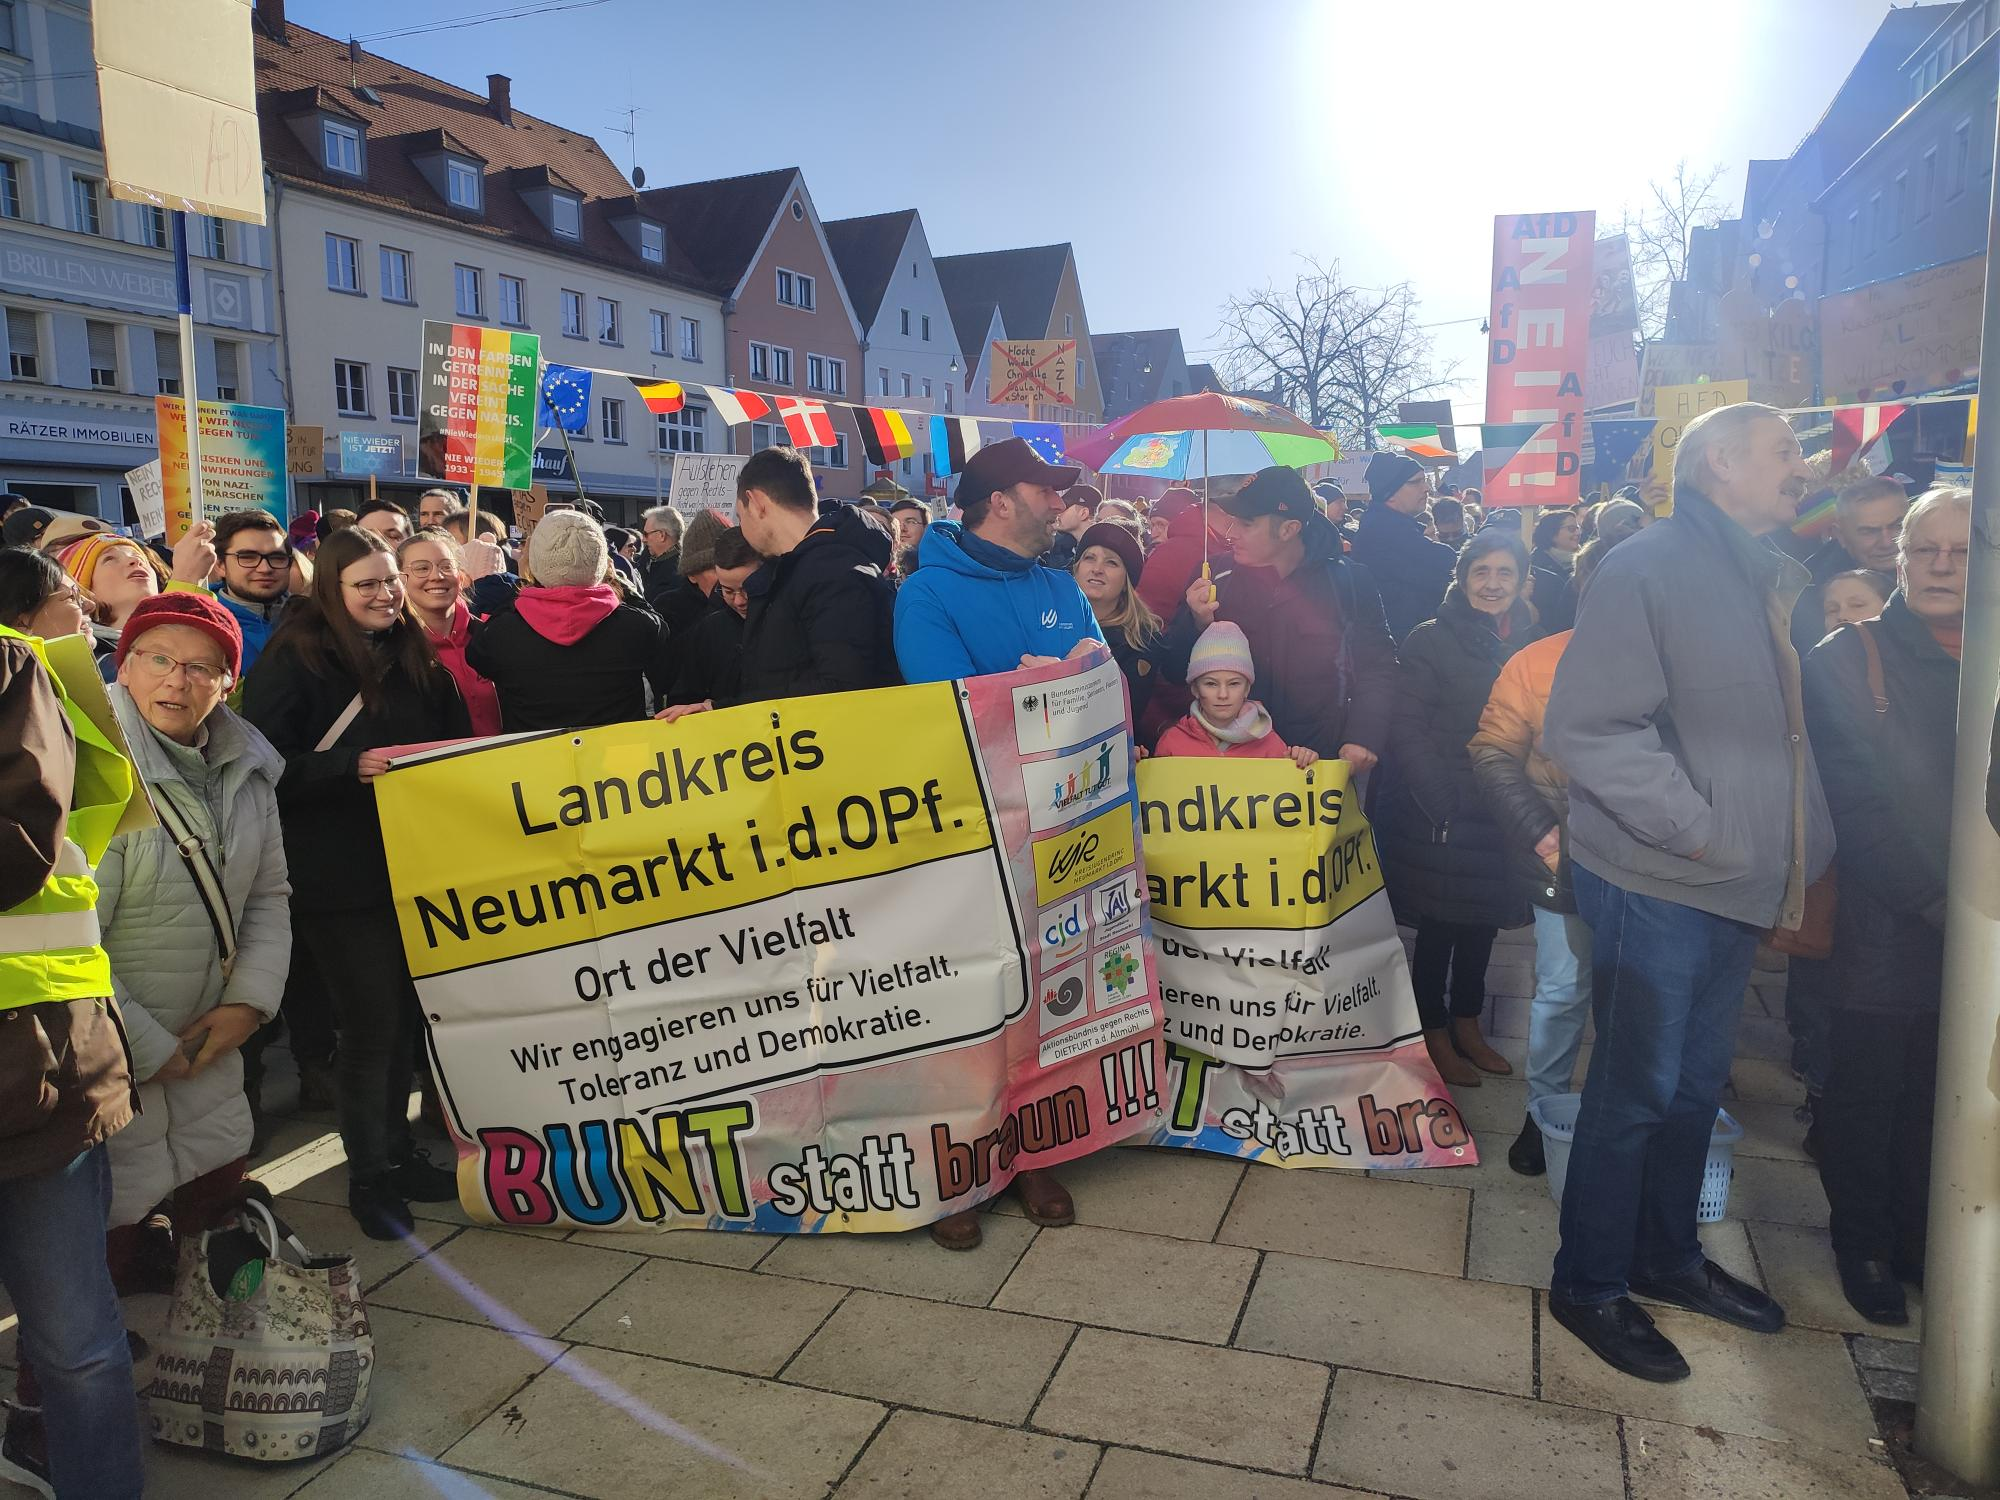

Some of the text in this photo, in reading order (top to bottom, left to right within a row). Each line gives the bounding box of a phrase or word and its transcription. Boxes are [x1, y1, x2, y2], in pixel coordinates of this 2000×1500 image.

[1512, 213, 1578, 239] AfD
[7, 250, 178, 300] BRILLEN WEBER
[429, 342, 532, 368] IN DEN FARBEN
[441, 360, 517, 381] GETRENNT.
[432, 373, 525, 397] IN DER SACHE
[162, 402, 181, 410] WIR
[449, 391, 507, 409] VEREINT
[206, 416, 229, 427] WIR
[430, 405, 524, 427] GEGEN NAZIS.
[1557, 371, 1583, 477] AfD
[9, 421, 154, 445] RÄTZER IMMOBILIEN
[343, 436, 401, 447] NIE WIEDER
[349, 444, 363, 453] IST
[444, 453, 462, 463] NIE
[127, 463, 155, 486] NEIN
[244, 458, 267, 468] UND
[444, 464, 468, 474] 1933
[223, 480, 254, 490] NAZI-
[677, 486, 700, 501] gegen
[1052, 706, 1065, 716] und
[512, 721, 825, 836] Landkreis
[1055, 789, 1084, 809] VIELFALT
[1084, 785, 1098, 795] TUT
[1140, 778, 1344, 834] ndkreis
[413, 779, 965, 948] Neumarkt i.d.OPf.
[1145, 861, 1250, 908] arkt
[1045, 903, 1081, 948] cjd
[575, 907, 855, 1004] Ort der Vielfalt
[1104, 942, 1131, 960] REGINA
[1230, 999, 1277, 1017] uns
[1285, 990, 1316, 1015] für
[1324, 977, 1382, 1016] Vielfalt,
[511, 954, 961, 1074] Wir engagieren uns für Vielfalt,
[1041, 1008, 1150, 1054] Aktionsbündnis gegen Rechts
[1054, 1038, 1093, 1059] DIETFURT
[1109, 1023, 1140, 1039] Altmühl
[1180, 1020, 1225, 1046] und
[558, 1009, 933, 1105] Toleranz und Demokratie.
[476, 1097, 756, 1227] BUNT
[768, 1133, 920, 1217] statt
[931, 1084, 1088, 1202] braun
[1100, 1038, 1161, 1126] !!!
[1221, 1093, 1470, 1162] statt bra
